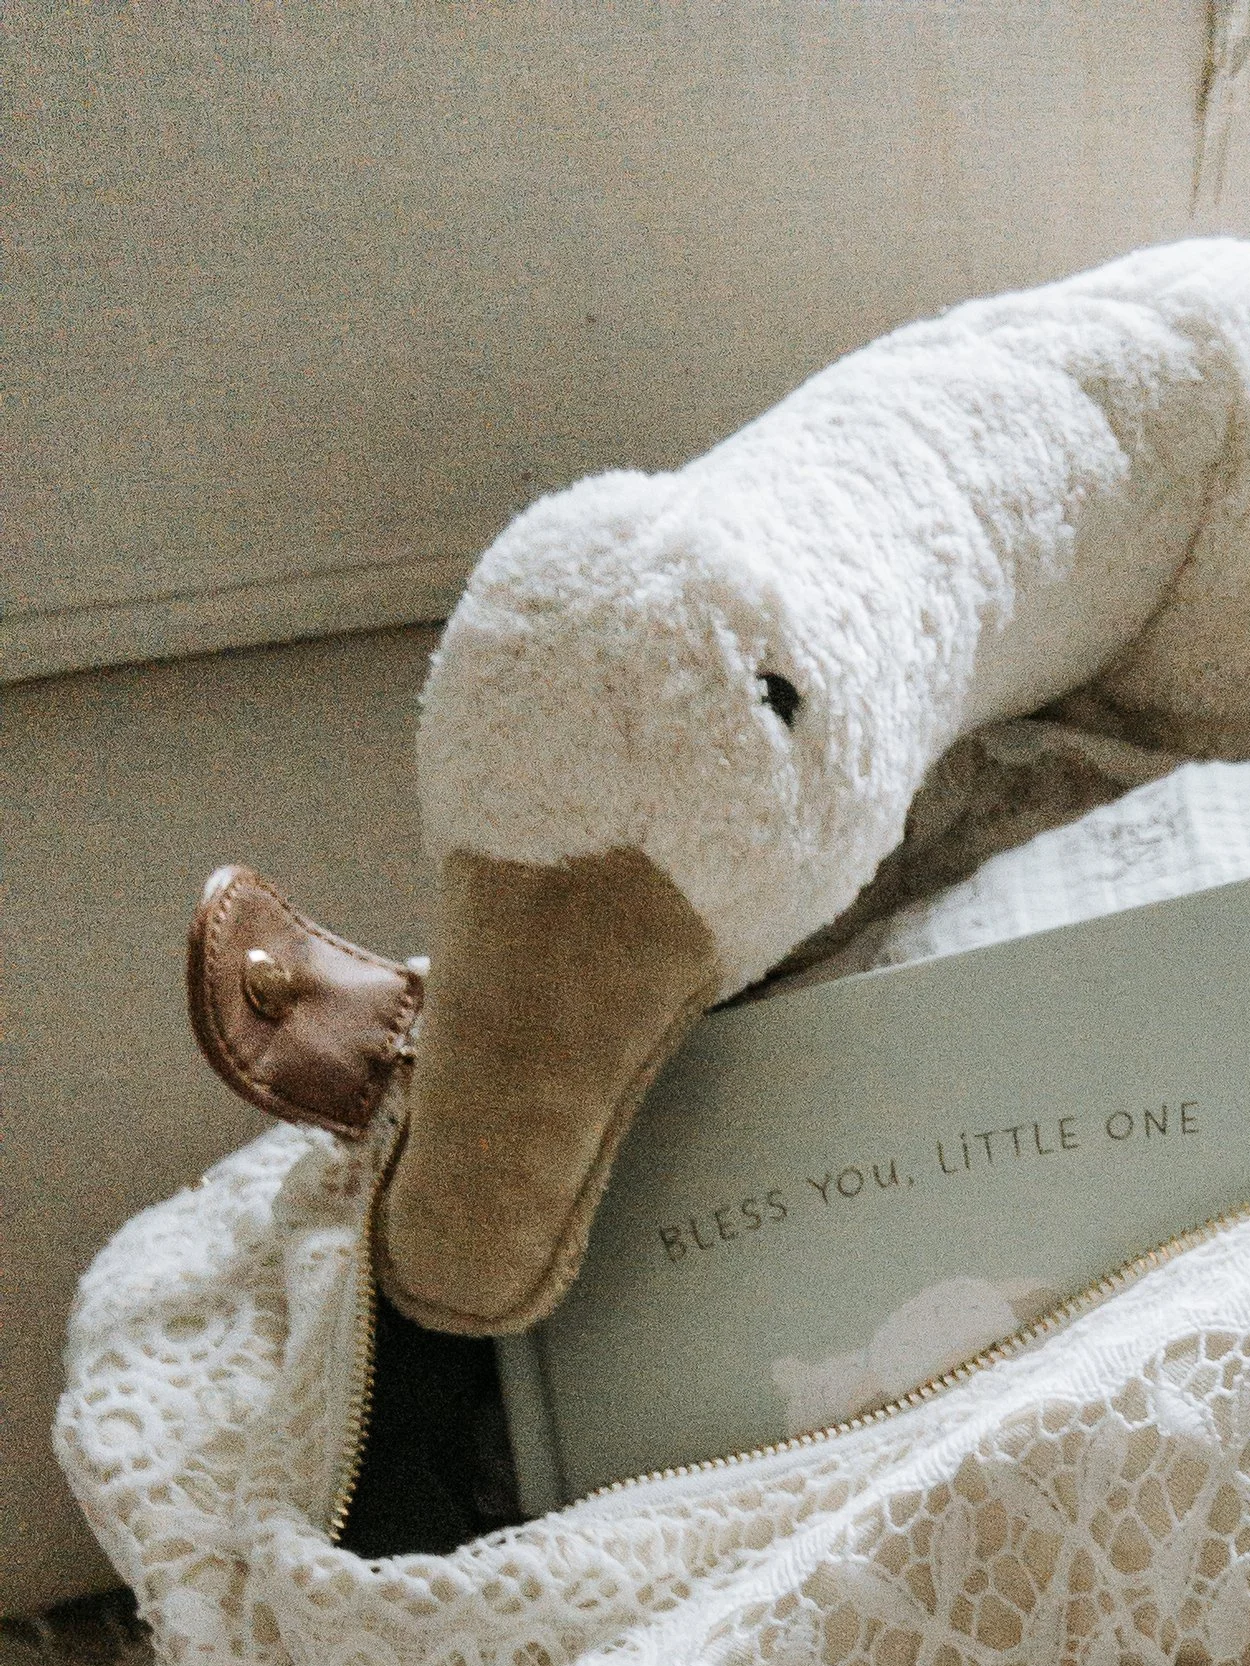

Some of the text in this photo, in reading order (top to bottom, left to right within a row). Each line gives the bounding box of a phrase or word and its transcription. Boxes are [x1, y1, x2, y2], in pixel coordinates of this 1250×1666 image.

[660, 1188, 788, 1262] BLESS
[806, 1159, 915, 1206] YOU,
[1105, 1101, 1201, 1141] ONE
